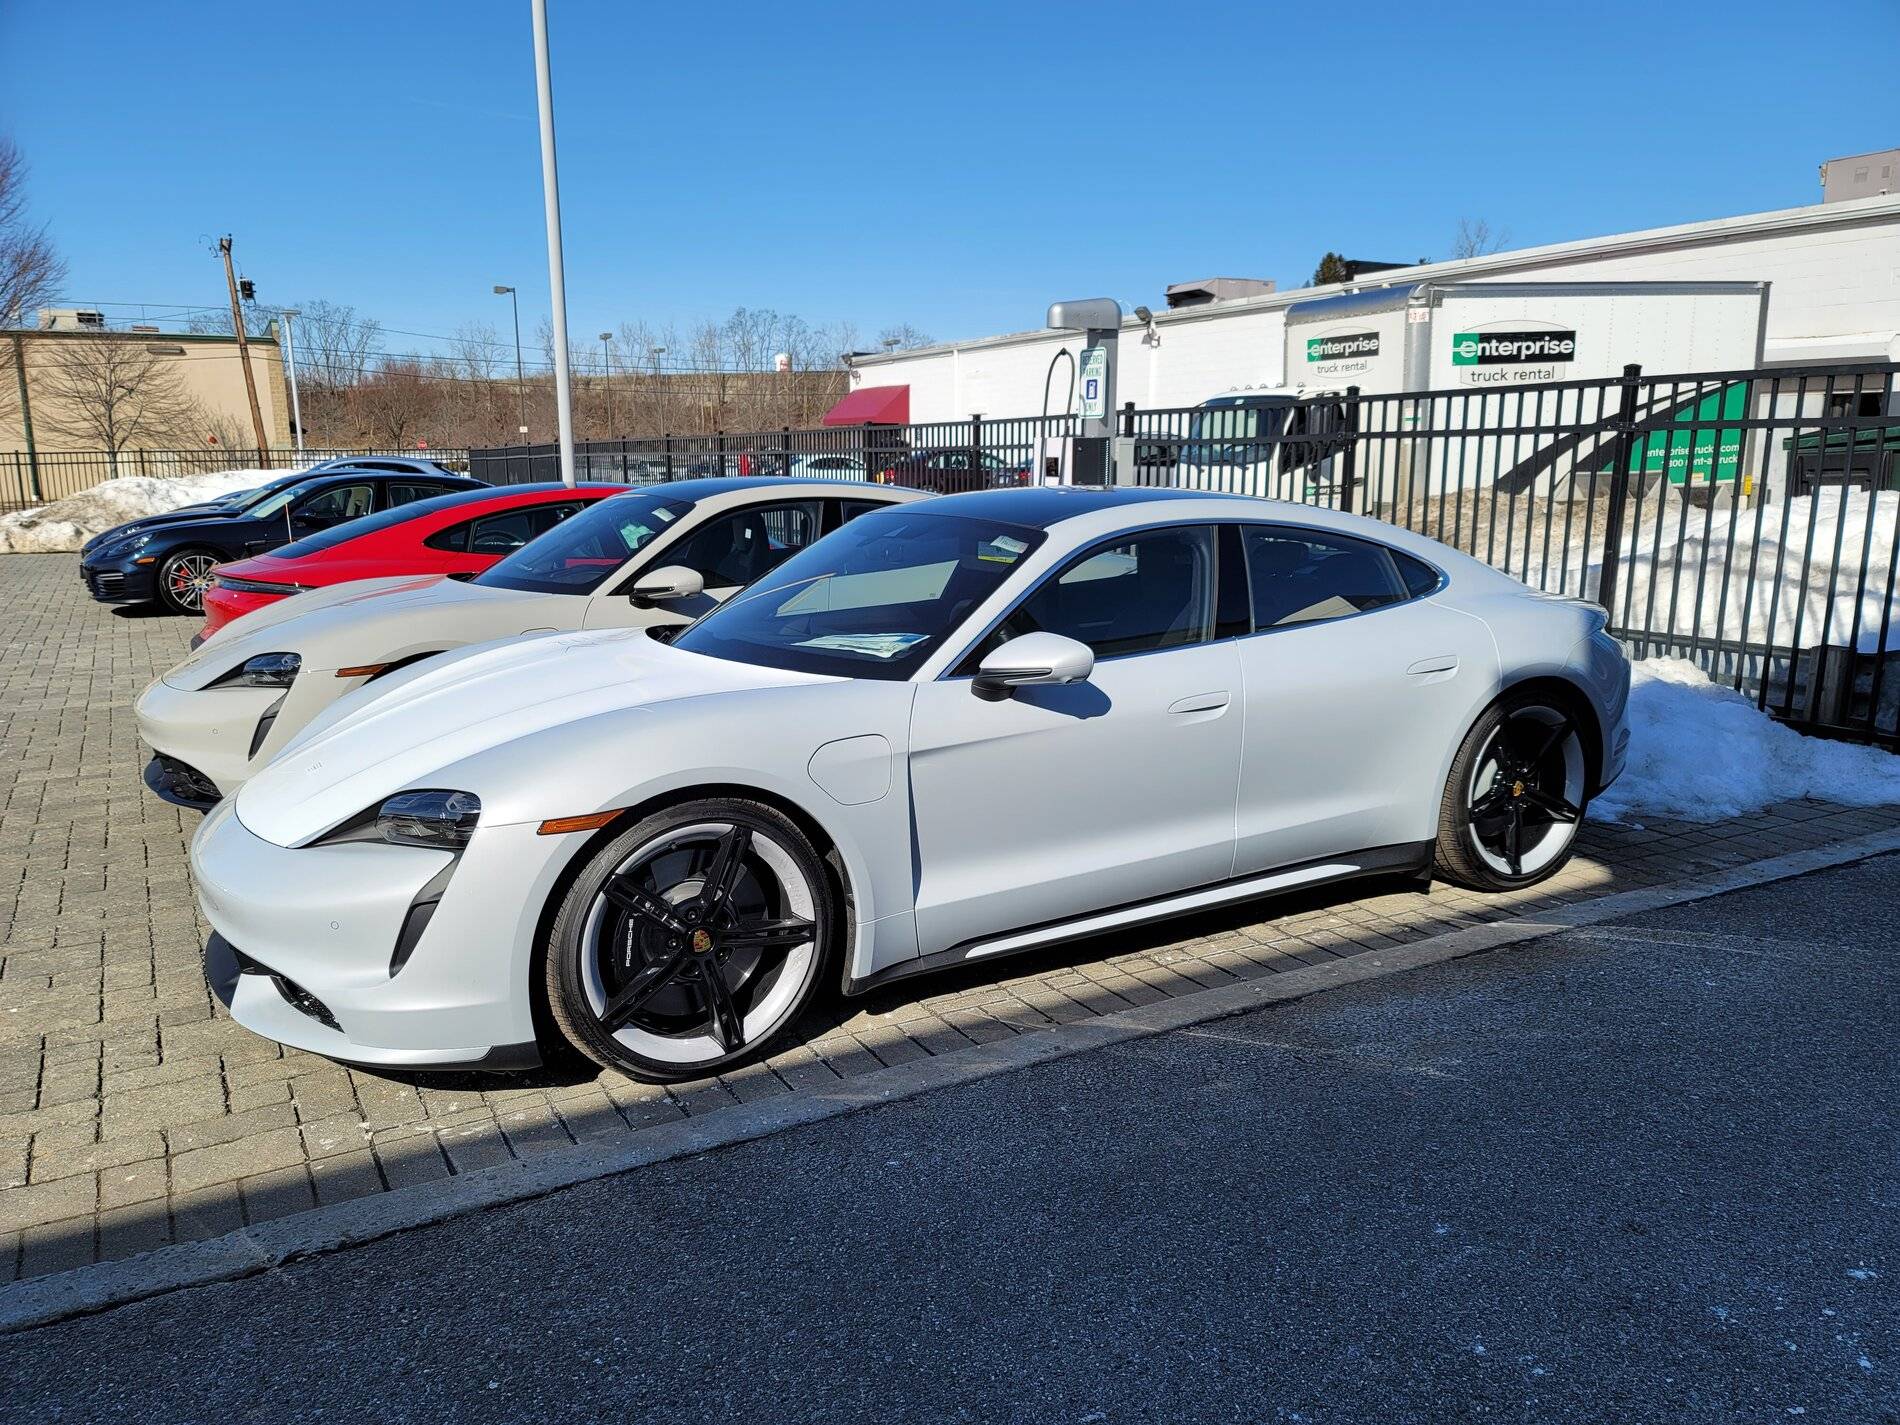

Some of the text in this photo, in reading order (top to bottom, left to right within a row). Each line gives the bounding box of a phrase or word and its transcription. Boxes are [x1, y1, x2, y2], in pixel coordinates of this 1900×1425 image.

[1309, 338, 1378, 356] enterprise
[1456, 336, 1575, 360] enterprise
[1317, 360, 1367, 373] truck rental
[1470, 366, 1555, 382] truck rental
[625, 919, 633, 967] PORSCHE
